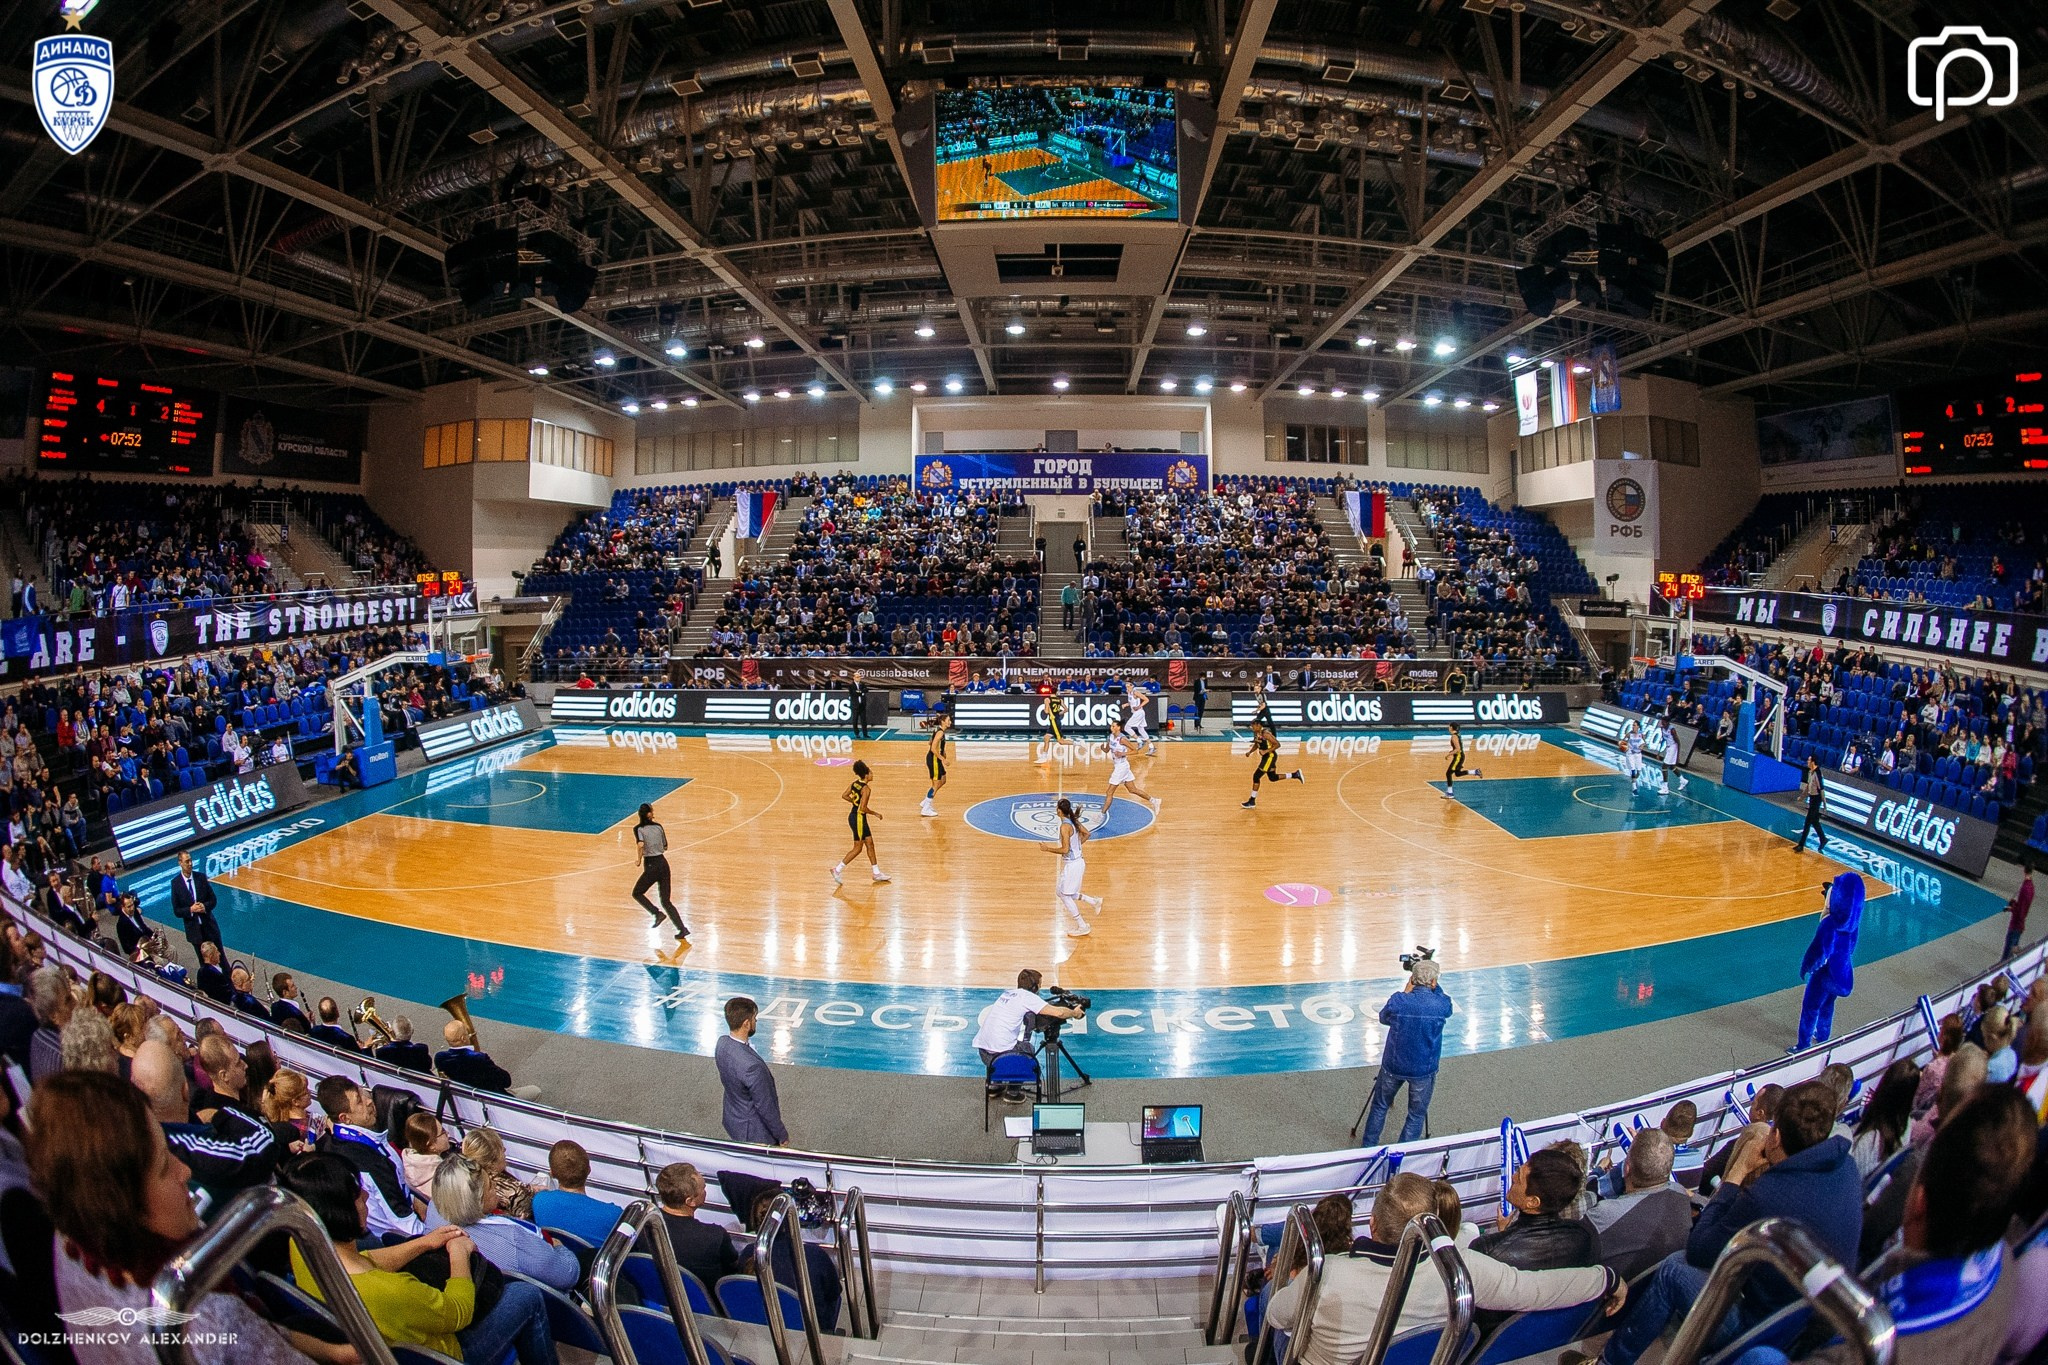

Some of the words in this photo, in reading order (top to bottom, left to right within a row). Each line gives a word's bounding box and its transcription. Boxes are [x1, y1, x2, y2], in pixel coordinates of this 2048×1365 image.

[2005, 396, 2015, 413] 2
[130, 405, 136, 417] 1
[160, 406, 170, 420] 2
[110, 432, 142, 447] 07:52
[1963, 433, 1994, 448] 07:52
[277, 441, 313, 454] КУРСКОЙ
[314, 446, 348, 458] ОБЛАСТИ
[1033, 458, 1093, 476] ГОРОД
[959, 475, 1073, 490] УСТРЕМЛЕННЫЙ
[1078, 478, 1088, 489] В
[1093, 477, 1163, 490] БУДУЩЕЕ!
[1610, 524, 1643, 539] РФБ
[448, 580, 463, 595] 24
[1666, 583, 1678, 597] 24
[1689, 584, 1704, 598] 24
[195, 611, 252, 644] THE
[269, 597, 416, 635] STRONGEST!
[1736, 597, 1777, 624] МЫ
[1862, 608, 2012, 657] СИЛЬНЕЕ
[30, 628, 96, 669] ARE
[694, 667, 725, 680] РФБ
[856, 668, 930, 679] @russiabasket
[1022, 667, 1098, 676] ЧЕМПИОНАТ
[1098, 667, 1149, 676] РОССИИ
[1409, 669, 1438, 678] molten
[610, 691, 677, 719] adidas
[775, 692, 852, 720] adidas
[1307, 693, 1383, 722] adidas
[1477, 693, 1543, 721] adidas
[471, 705, 525, 742] adidas
[369, 752, 389, 763] molten
[1729, 757, 1749, 769] molten
[194, 776, 277, 831] adidas
[1018, 801, 1103, 810] ДИНМО
[1874, 796, 1956, 855] adidas
[643, 979, 1464, 1034] #десьскетбо
